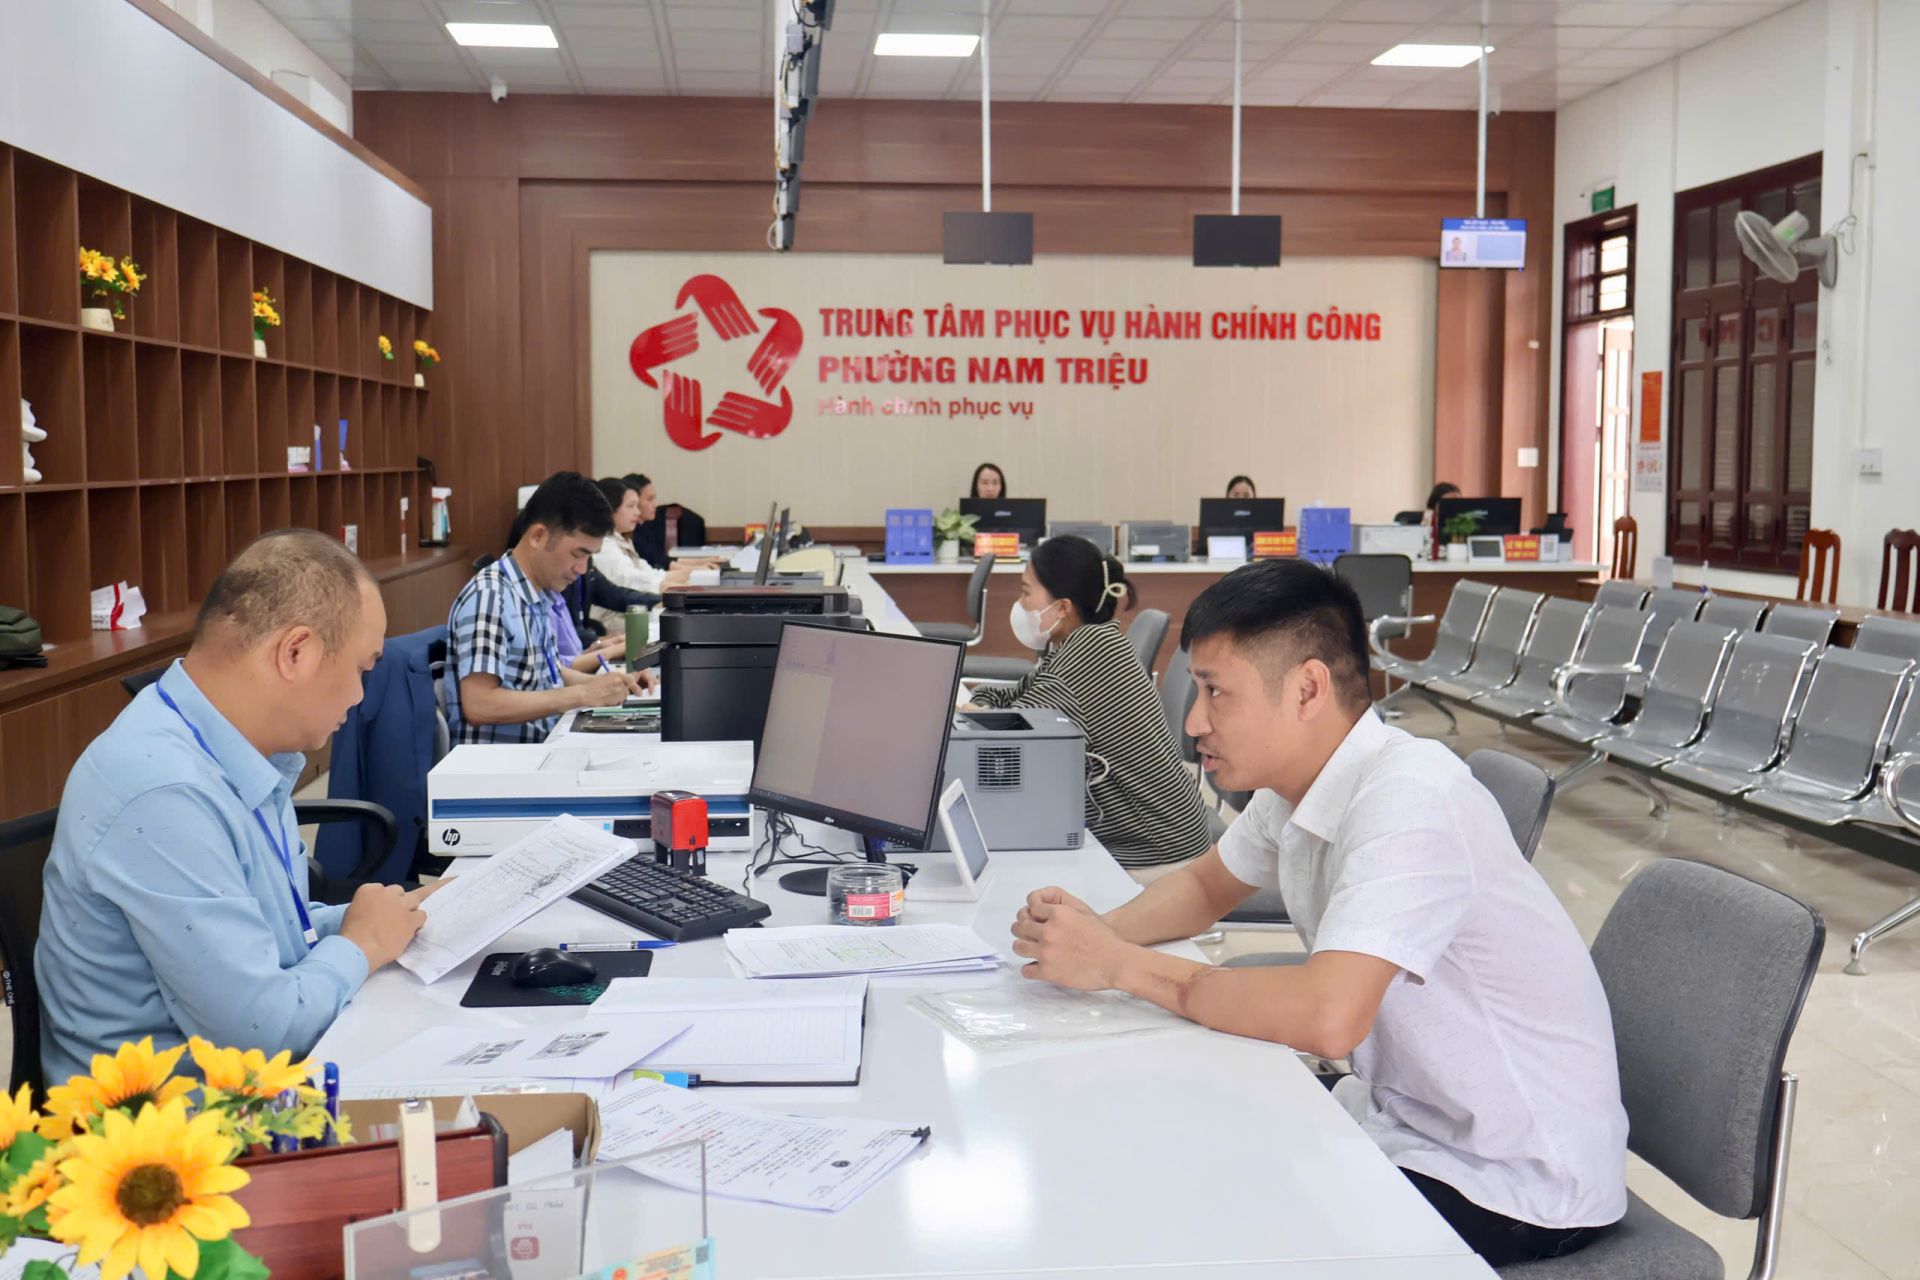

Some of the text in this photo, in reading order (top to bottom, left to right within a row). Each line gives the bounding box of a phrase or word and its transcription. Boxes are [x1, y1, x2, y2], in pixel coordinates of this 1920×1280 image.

[818, 303, 1382, 346] TRUNG TÂM PHỤC VỤ HÀNH CHÍNH CÔNG
[818, 349, 1149, 391] PHƯỜNG NAM TRIỆU
[818, 396, 876, 416] Hành
[948, 397, 1003, 420] phục
[1008, 401, 1035, 420] vụ
